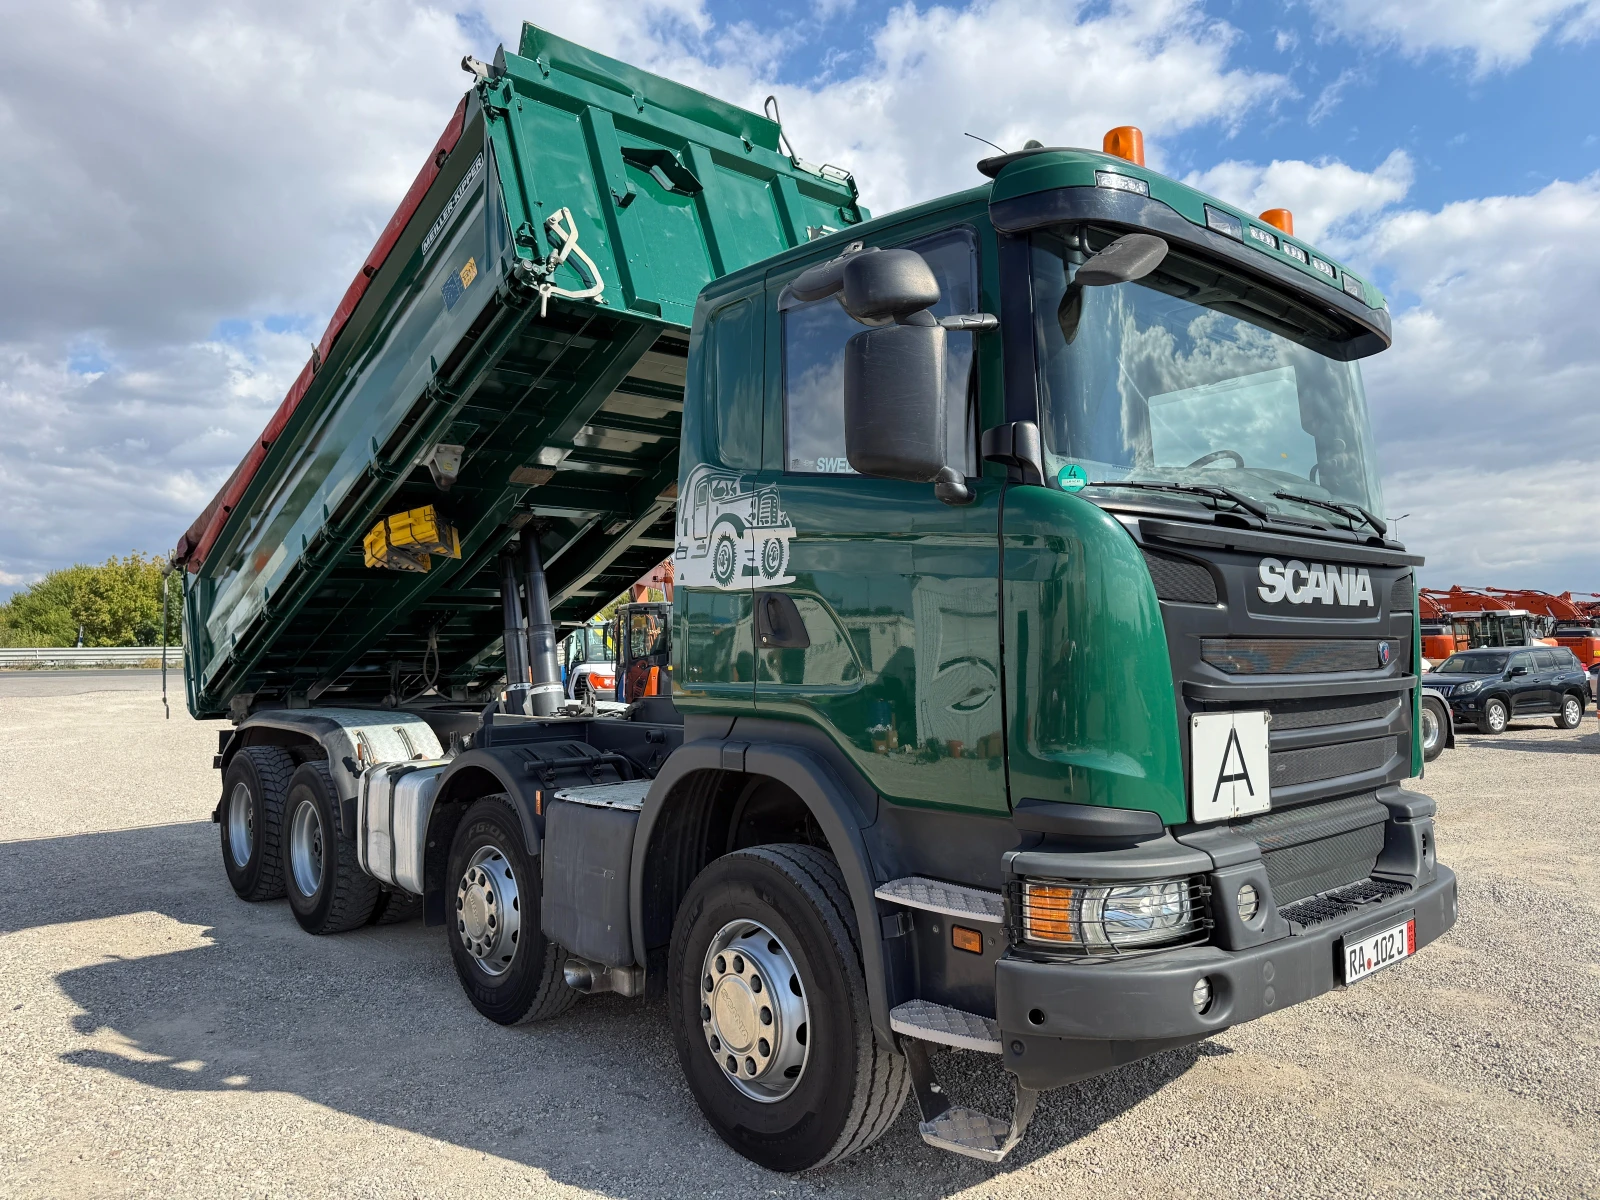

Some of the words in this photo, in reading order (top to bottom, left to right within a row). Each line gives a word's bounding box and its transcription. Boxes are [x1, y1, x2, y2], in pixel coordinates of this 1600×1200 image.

[423, 157, 482, 251] MEILLER-KIPPER
[1068, 466, 1077, 478] 4
[1257, 557, 1375, 607] SCANIA
[1212, 727, 1255, 803] A
[1349, 946, 1366, 978] RA
